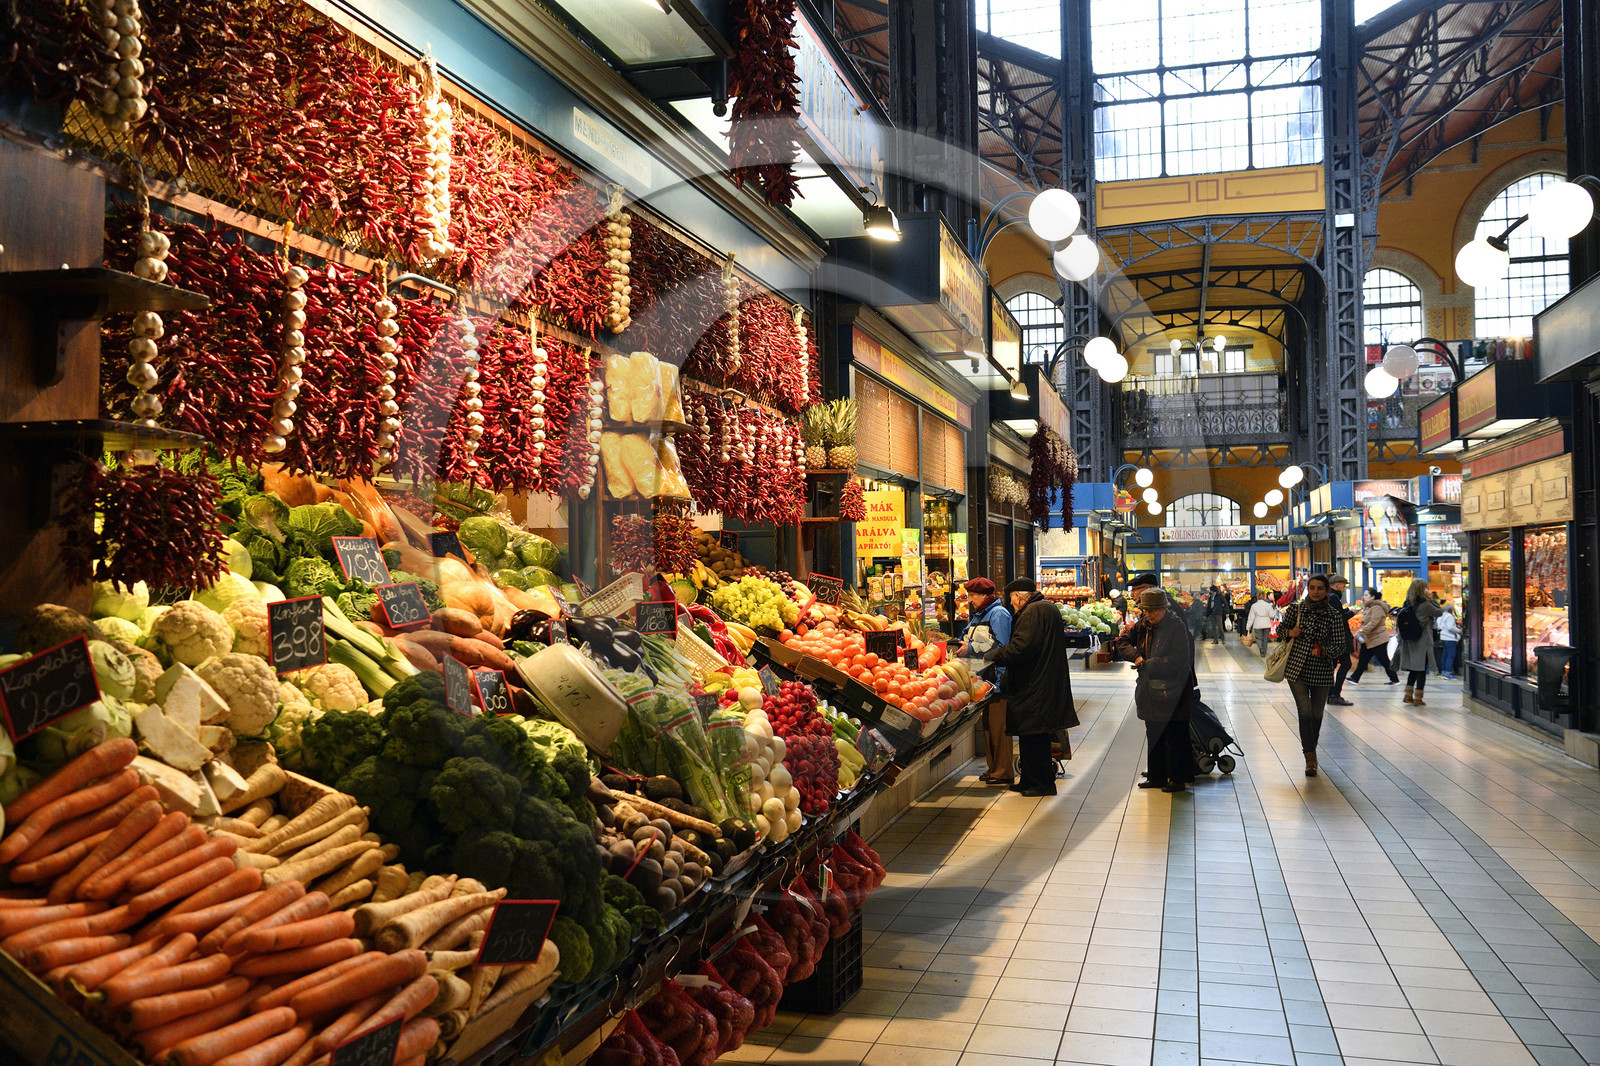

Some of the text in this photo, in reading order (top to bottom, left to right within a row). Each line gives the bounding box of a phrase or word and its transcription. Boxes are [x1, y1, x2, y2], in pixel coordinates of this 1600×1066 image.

[870, 501, 893, 512] MÁK
[856, 526, 896, 536] ARÁLVA
[856, 541, 891, 550] APHATÓ!
[273, 620, 322, 663] 398
